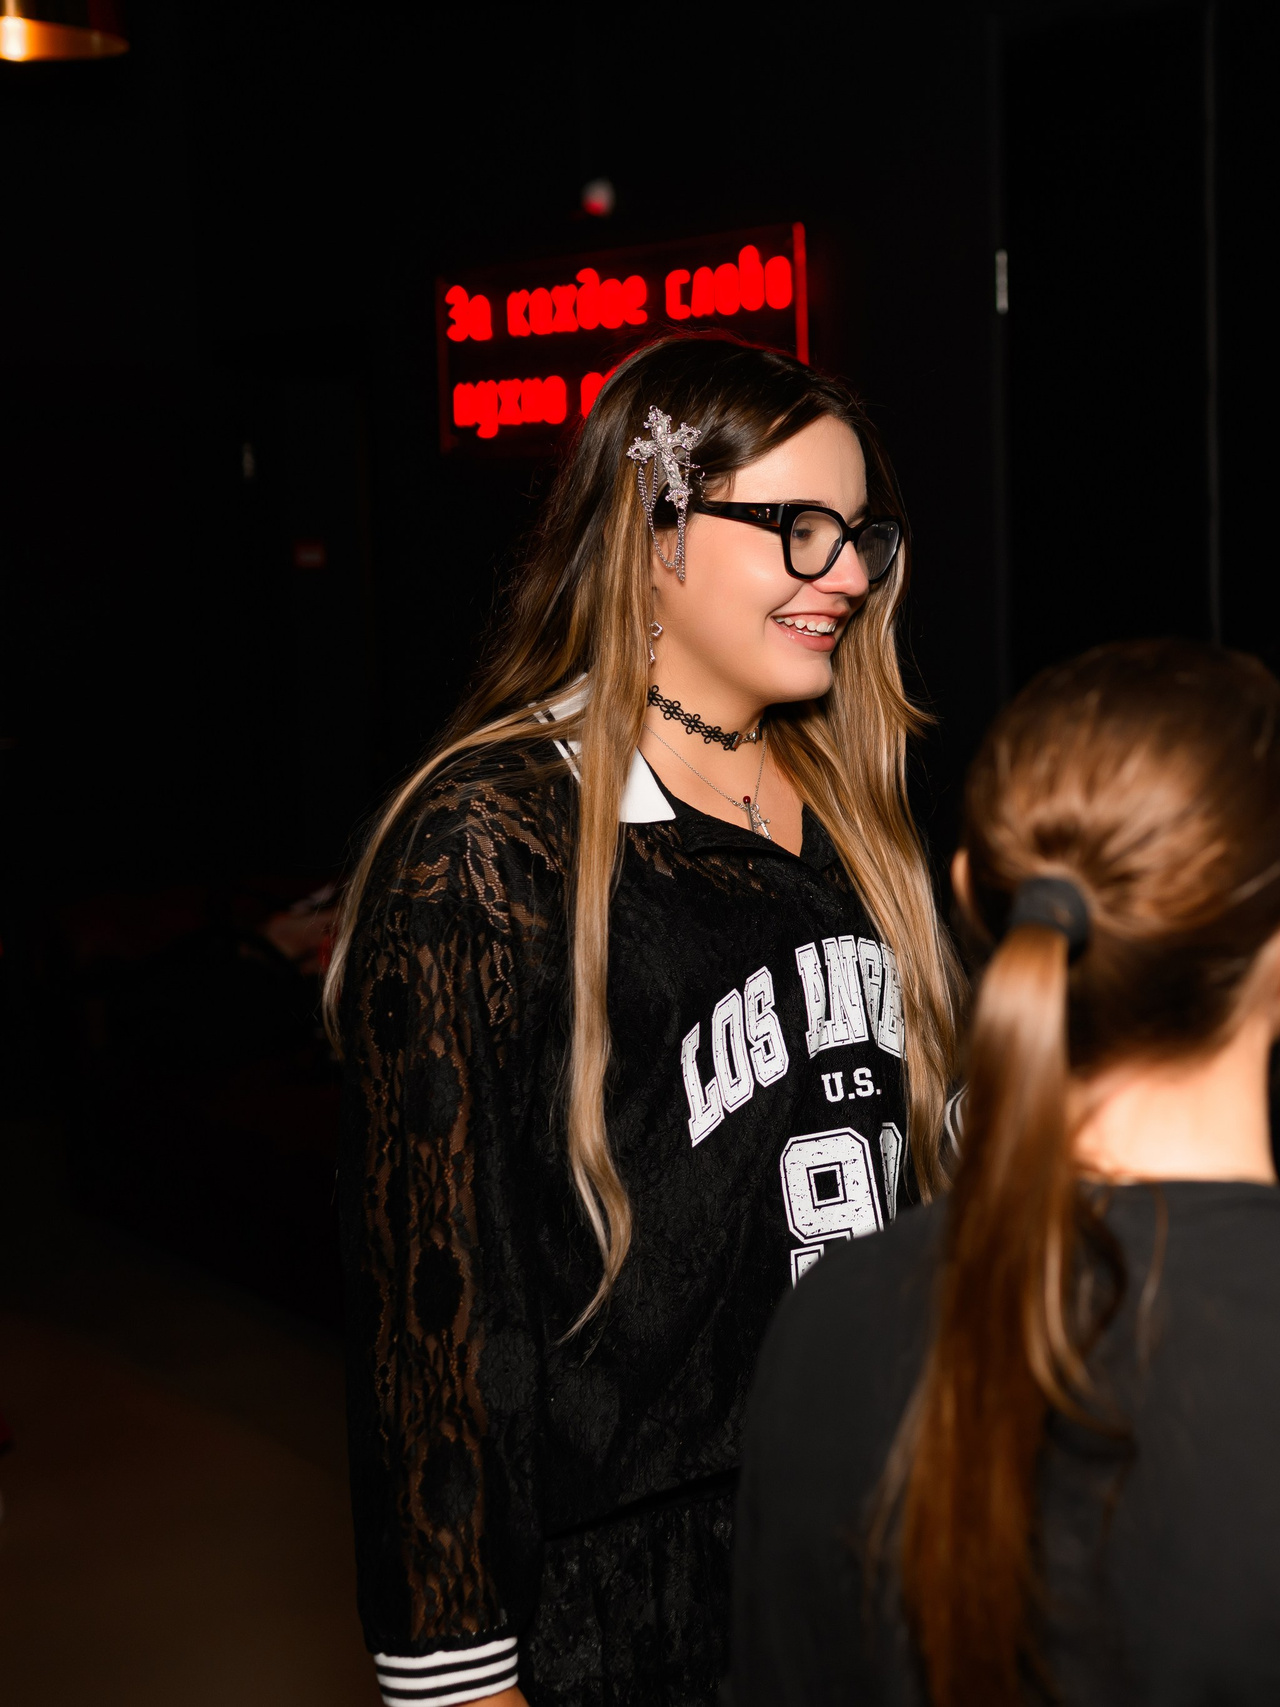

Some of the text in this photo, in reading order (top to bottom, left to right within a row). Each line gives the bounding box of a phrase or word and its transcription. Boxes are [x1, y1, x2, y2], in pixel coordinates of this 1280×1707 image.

[445, 285, 493, 342] За
[665, 244, 793, 321] слово
[681, 966, 789, 1147] LOS
[821, 1066, 883, 1103] U.S.
